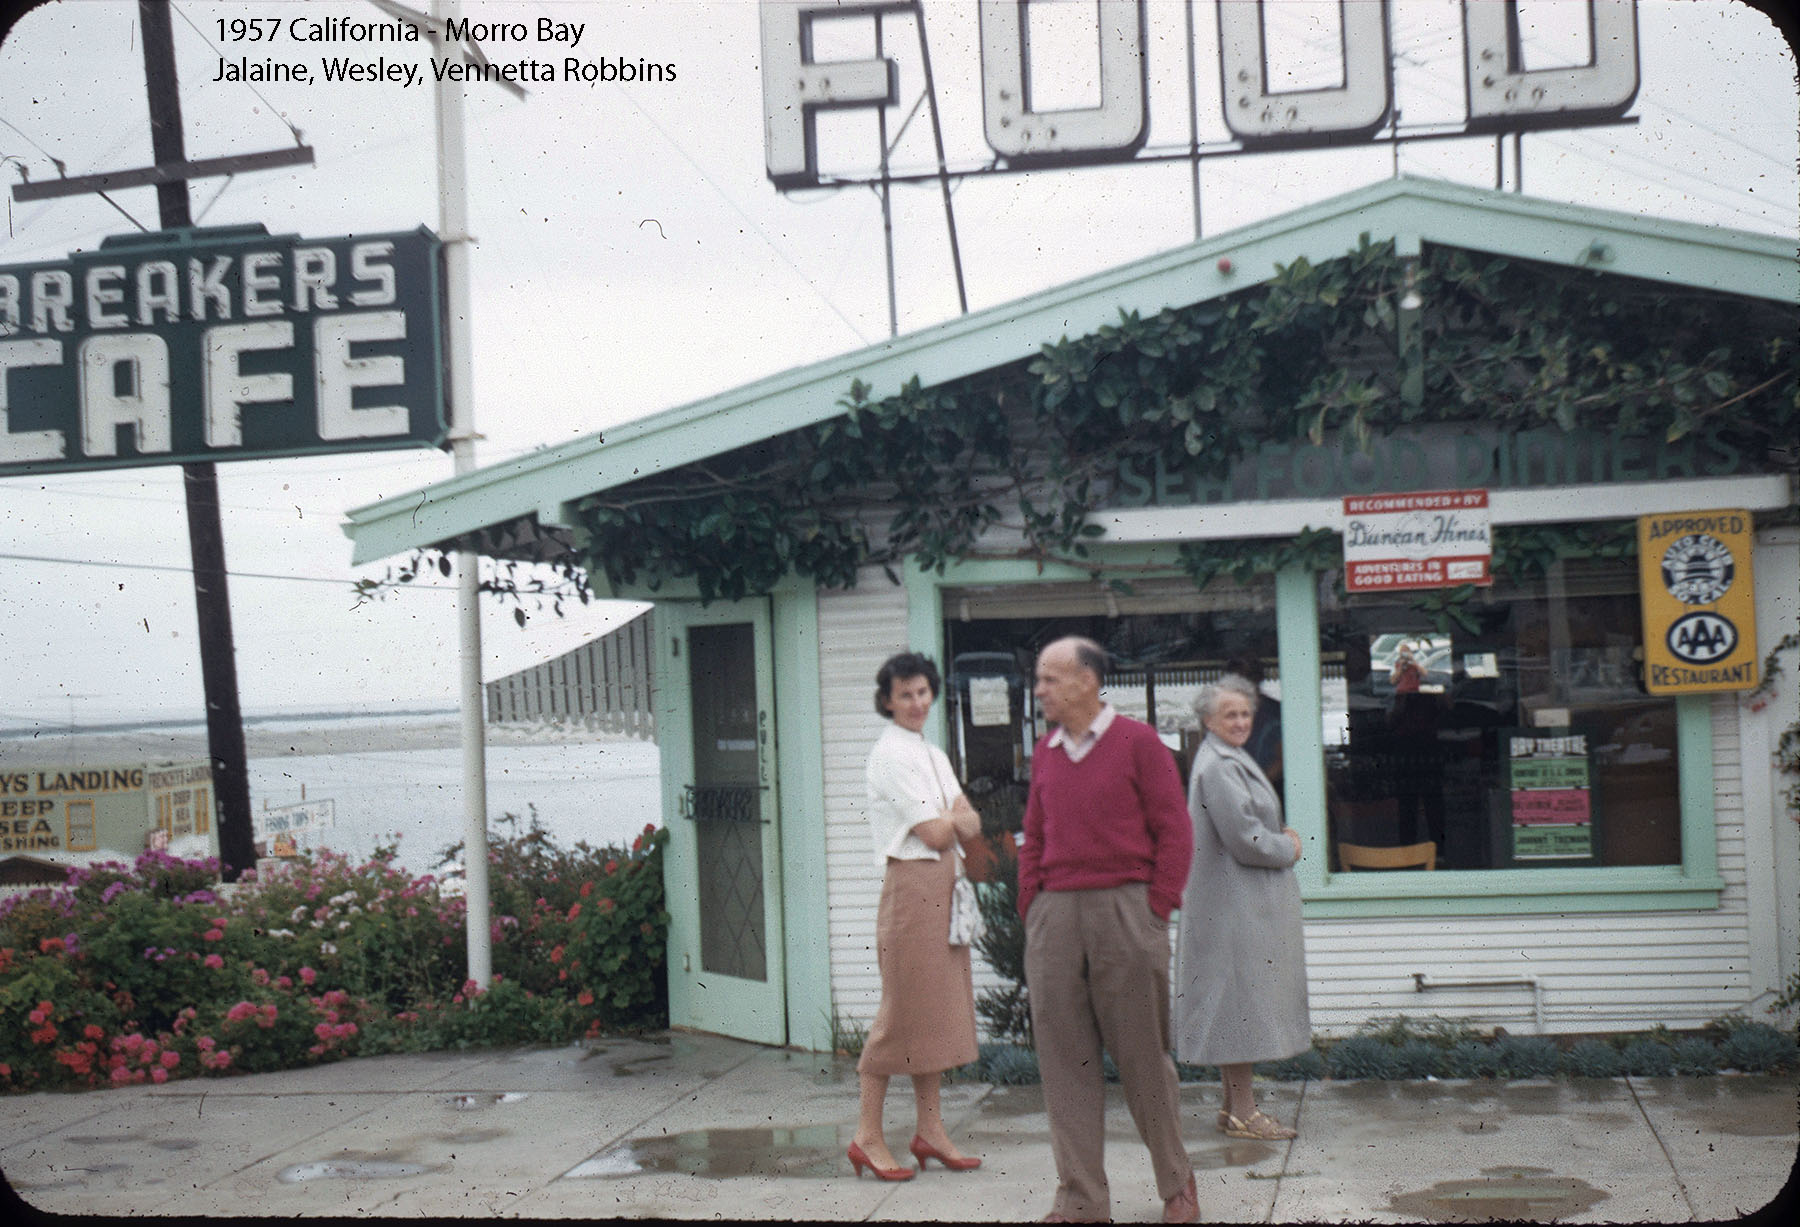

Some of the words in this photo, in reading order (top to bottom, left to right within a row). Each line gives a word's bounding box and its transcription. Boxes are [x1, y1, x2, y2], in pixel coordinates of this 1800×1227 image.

[0, 310, 410, 463] CAFE
[1258, 437, 1427, 500] FOOD
[1350, 495, 1450, 511] RECOMMENDED
[1464, 494, 1482, 505] BY
[1347, 520, 1428, 547] Duncan
[1430, 515, 1487, 544] Hines
[1650, 515, 1743, 540] APPROVED
[1354, 562, 1424, 576] ADVENTURES
[1427, 560, 1441, 571] IN
[1354, 574, 1393, 586] GOOD
[1396, 572, 1443, 584] EATING
[1677, 618, 1726, 656] AAA
[1651, 662, 1753, 686] RESTAURANT
[37, 769, 144, 793] LANDING
